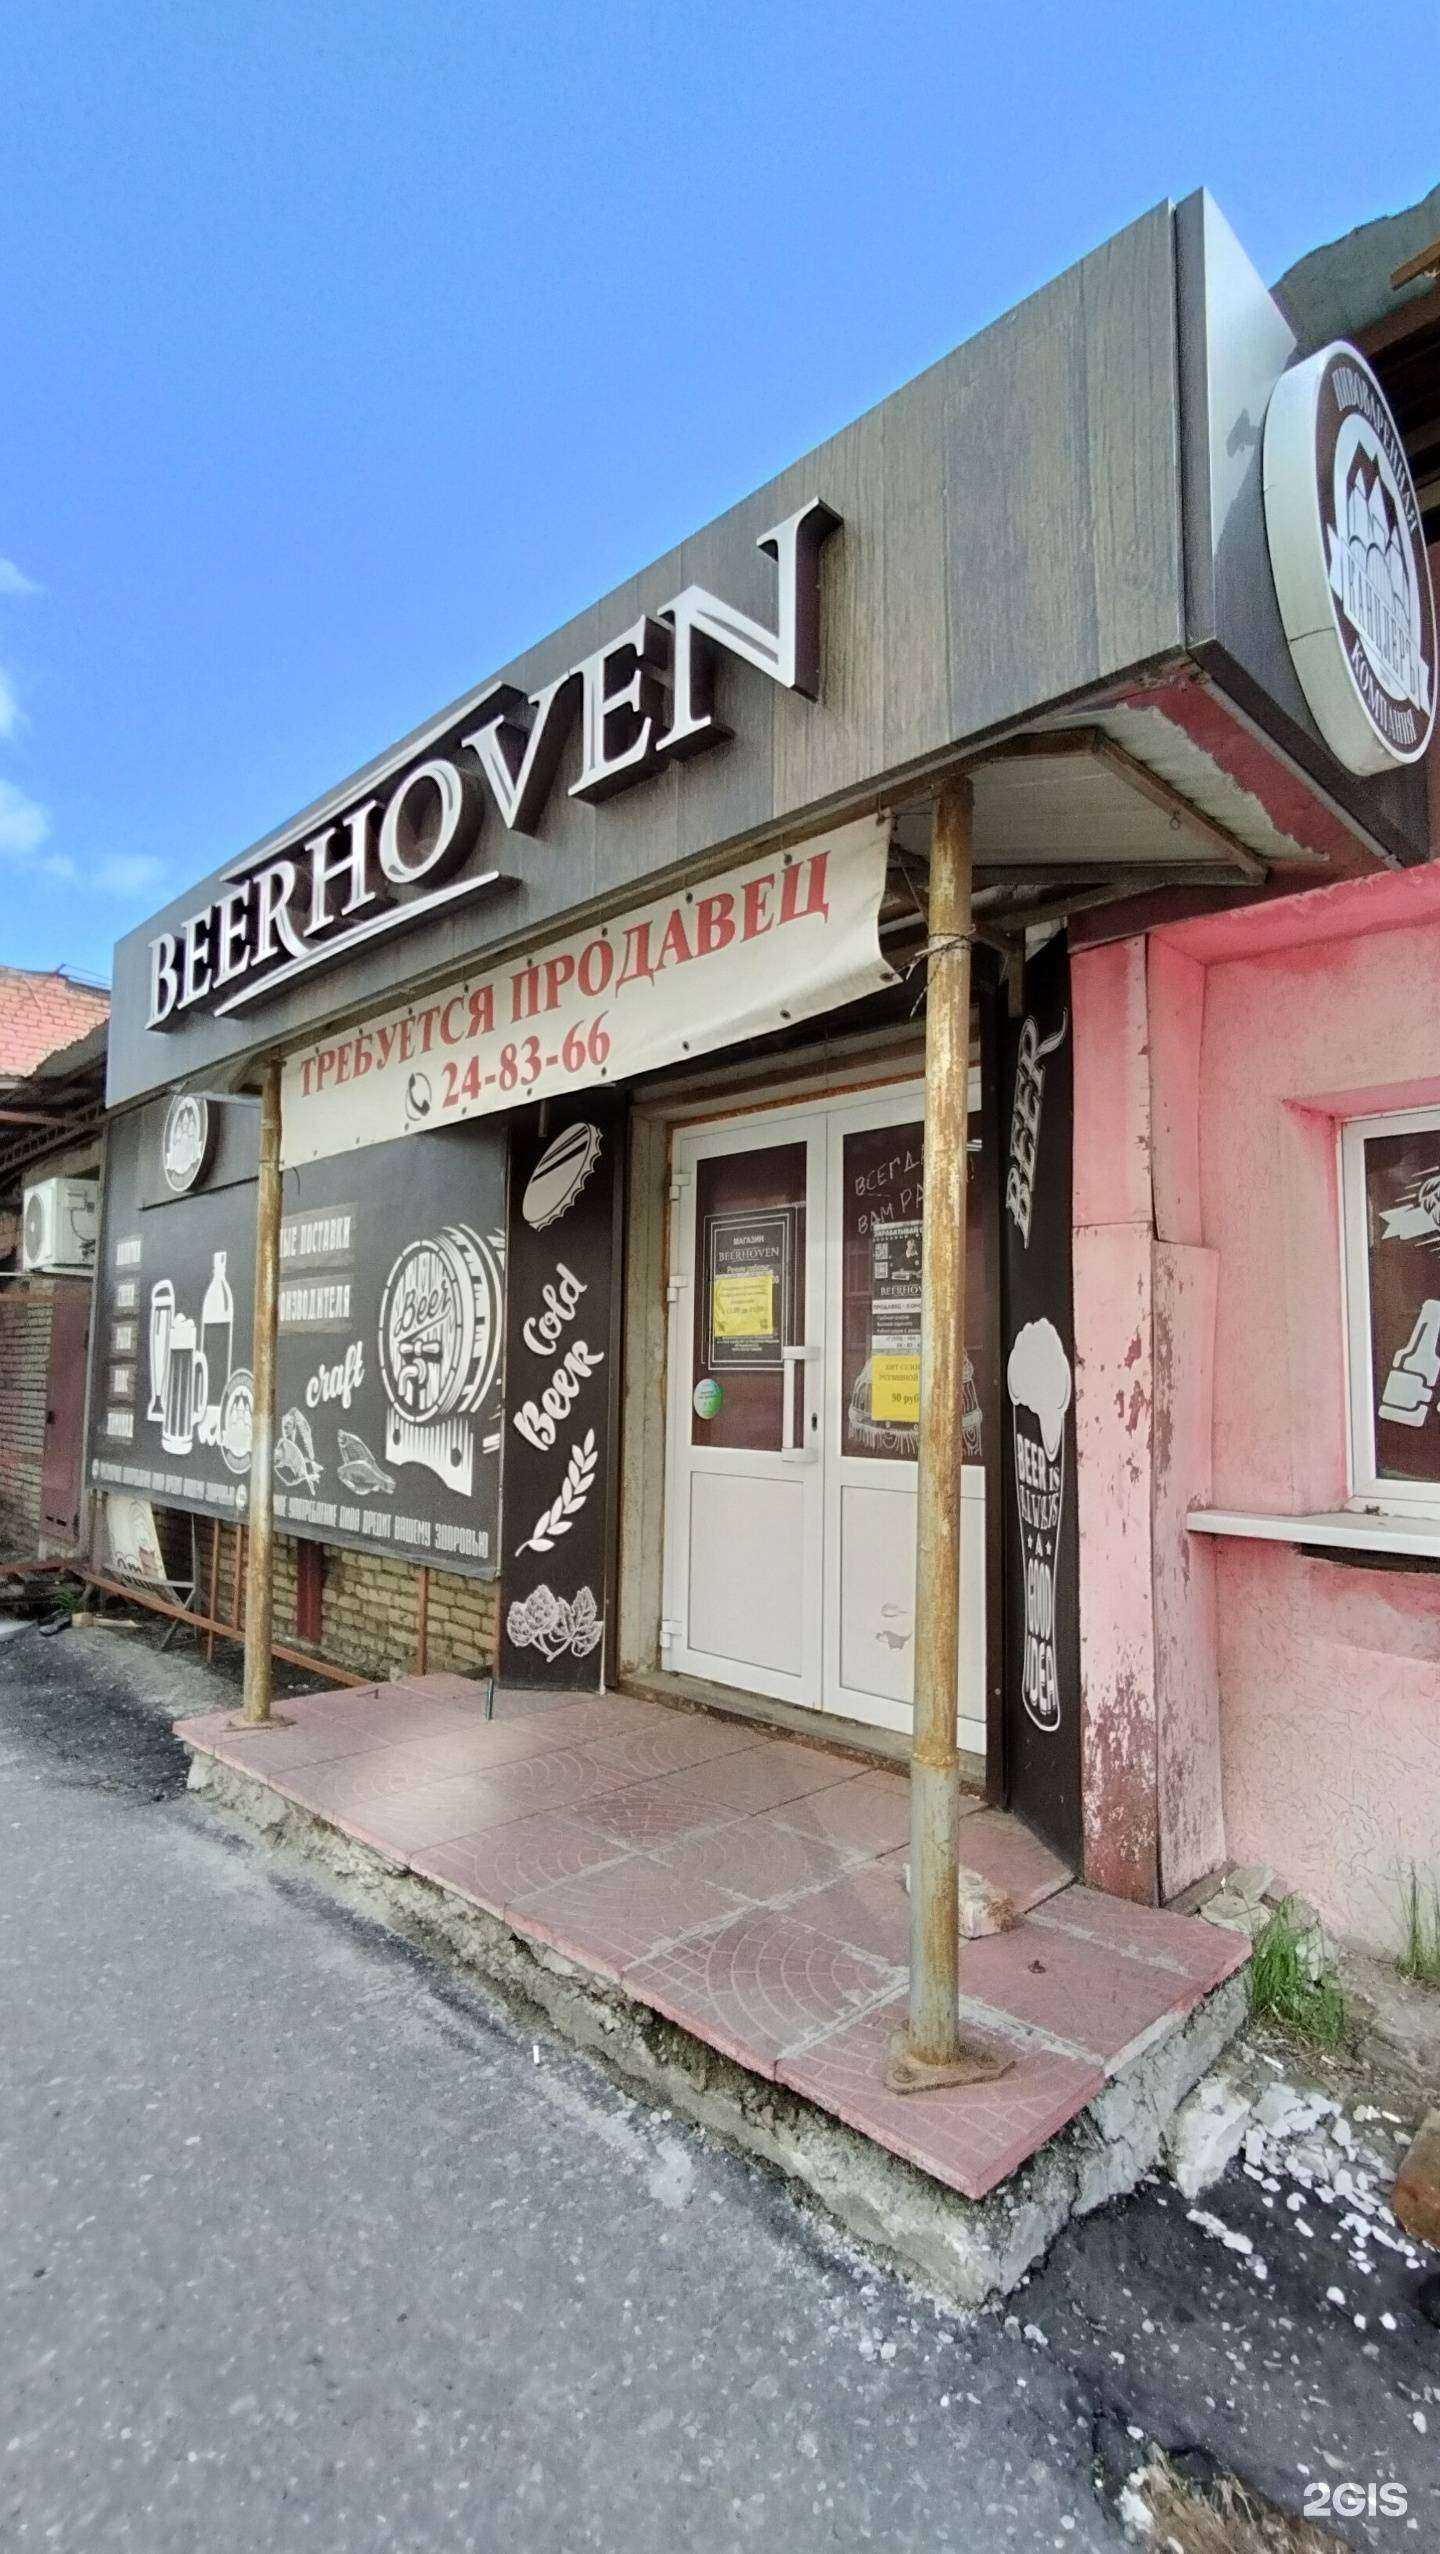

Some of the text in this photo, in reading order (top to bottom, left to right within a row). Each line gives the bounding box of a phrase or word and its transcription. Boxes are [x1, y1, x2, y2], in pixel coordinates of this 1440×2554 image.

[1351, 636, 1417, 746] КОМПАНИЯ
[145, 496, 838, 1033] BEERHOVEN
[299, 851, 831, 1099] ТРЕБУЕТСЯ ПРОДАВЕЦ
[440, 1011, 612, 1109] 24-83-66
[733, 1234, 765, 1246] МАГАЗИН
[858, 1202, 894, 1235] ВАМ
[718, 1246, 780, 1263] BEERHOVEN
[394, 1279, 453, 1337] Beer
[523, 1262, 588, 1356] Cold
[306, 1340, 365, 1409] craft
[1016, 1433, 1047, 1491] BEER
[434, 1522, 489, 1559] ЗДОРОВЬЮ
[1035, 1532, 1043, 1557] A
